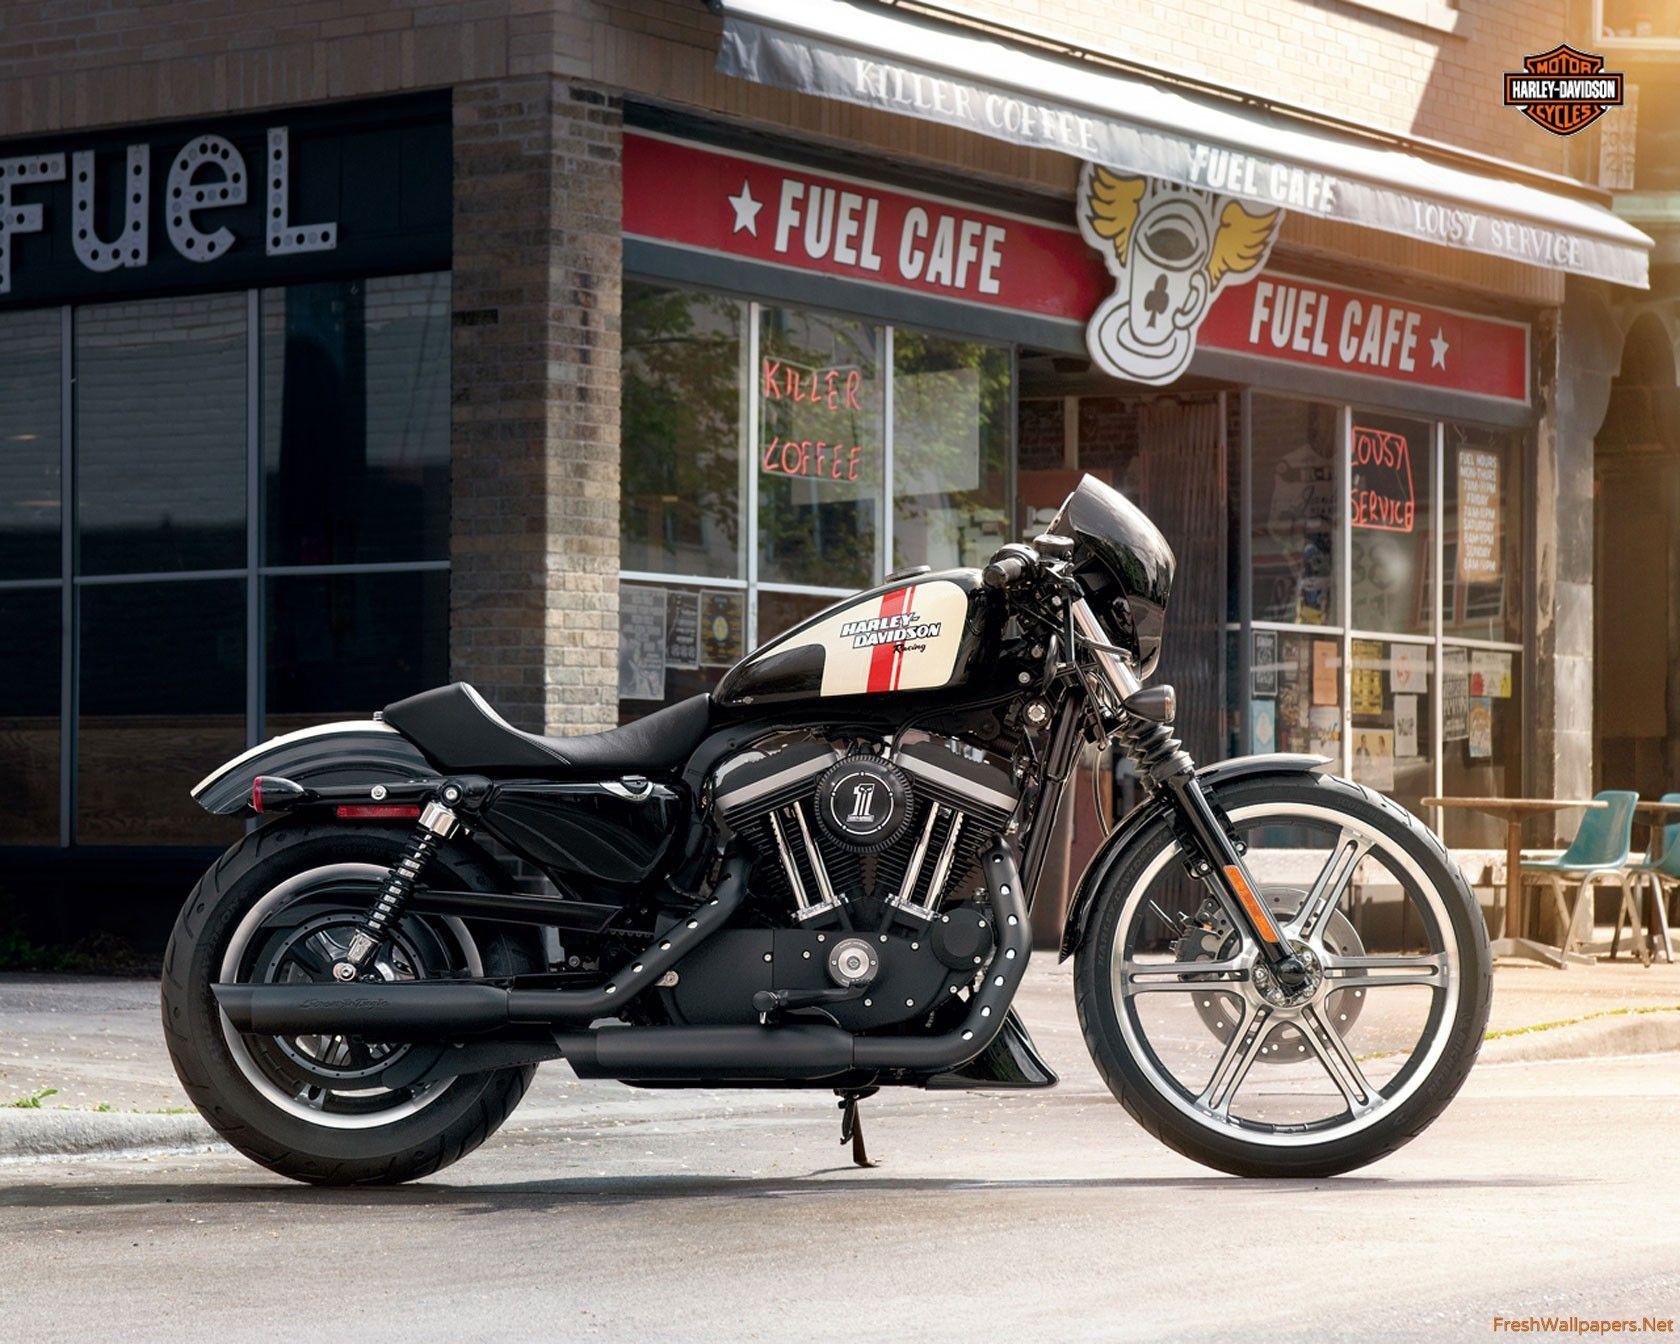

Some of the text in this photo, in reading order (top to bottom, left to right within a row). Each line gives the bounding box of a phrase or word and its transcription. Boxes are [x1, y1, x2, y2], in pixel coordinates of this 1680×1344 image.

[855, 57, 1098, 153] KILLER COFFEE
[1190, 143, 1338, 213] FUEL CAFE
[774, 178, 1006, 294] FUEL CAFE
[1413, 200, 1584, 267] LOUSY SERVICE
[1248, 279, 1422, 373] FUEL CAFE
[763, 356, 862, 411] KILLER
[853, 622, 941, 649] DAVIDSON
[893, 643, 926, 654] Racing
